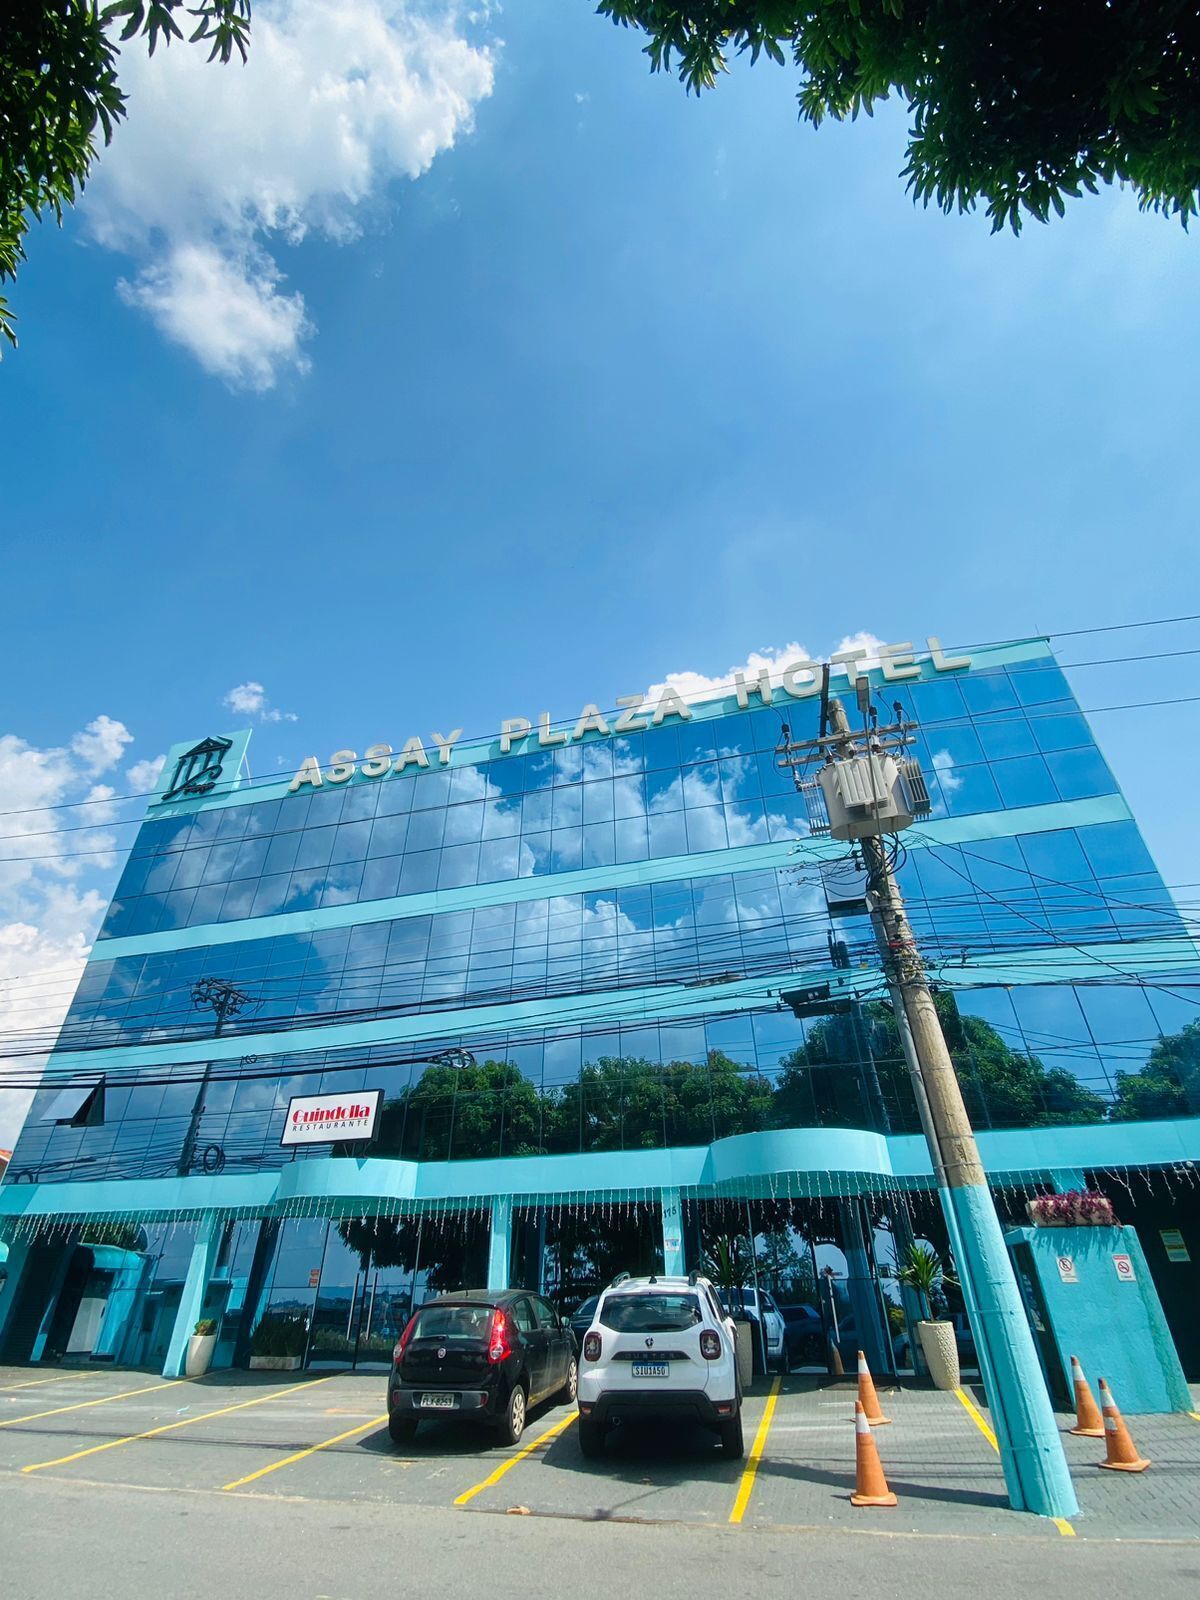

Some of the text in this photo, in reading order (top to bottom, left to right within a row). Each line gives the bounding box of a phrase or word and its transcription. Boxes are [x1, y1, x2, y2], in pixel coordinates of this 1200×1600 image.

[288, 636, 972, 792] ASSAY PLAZA HOTEL
[292, 1119, 368, 1132] RESTAURANTE
